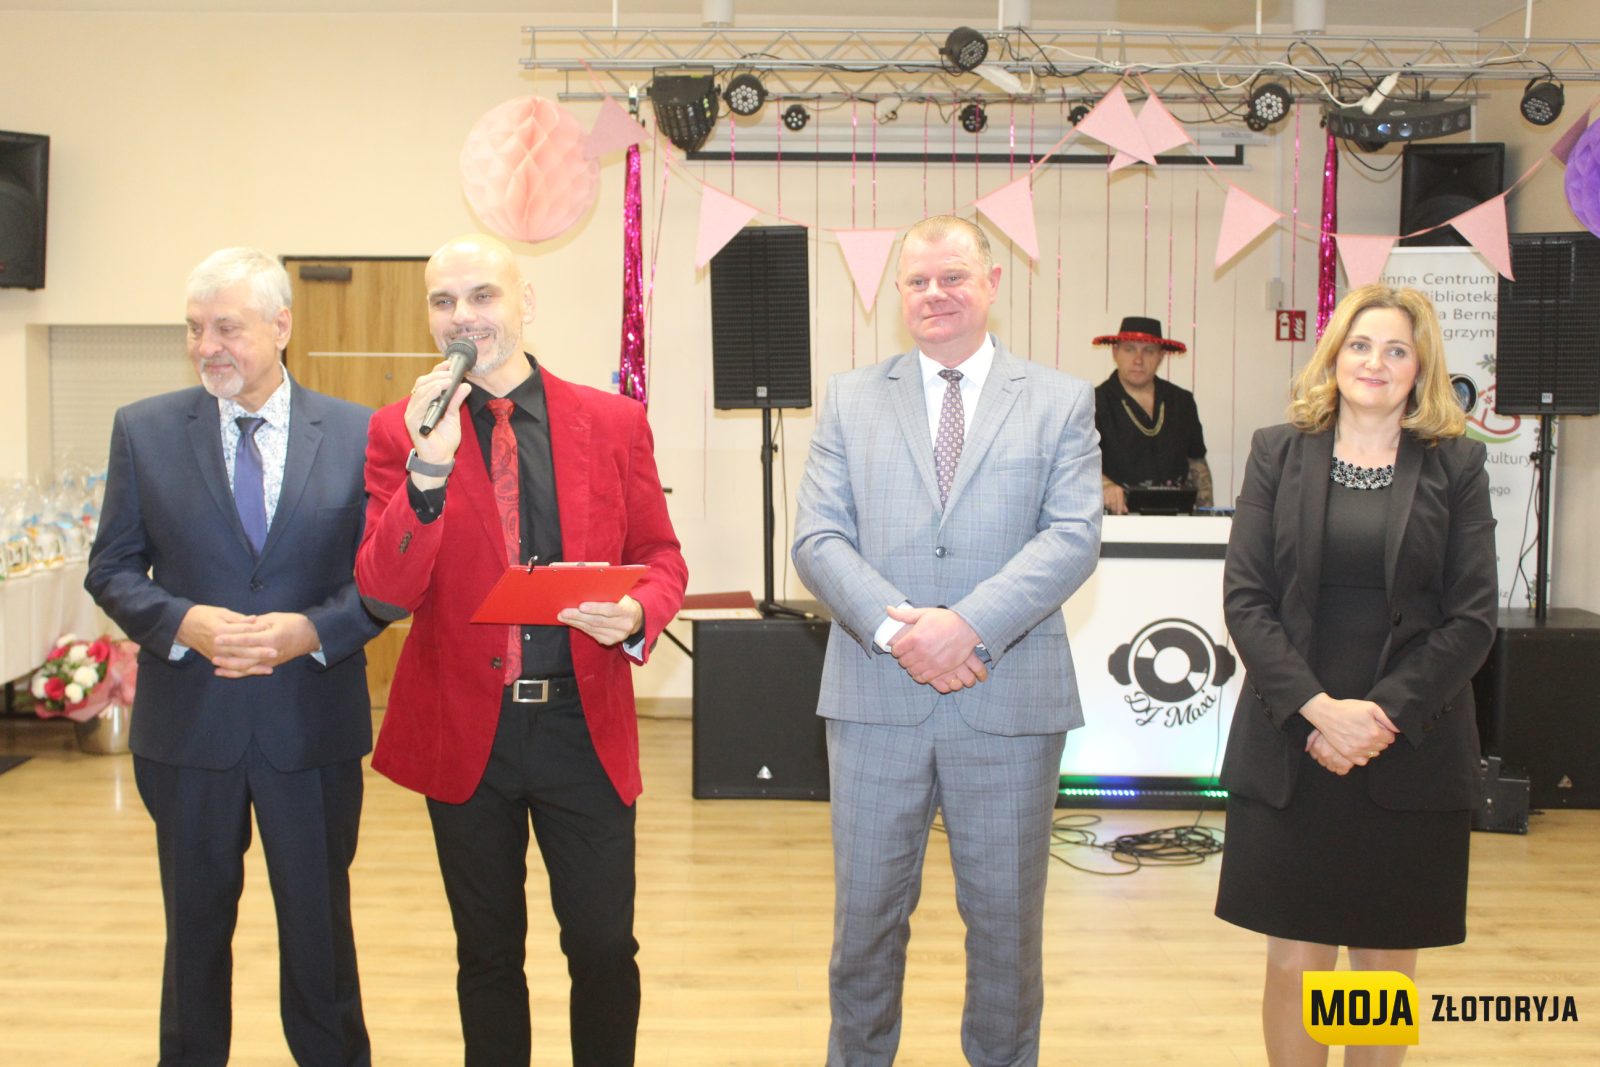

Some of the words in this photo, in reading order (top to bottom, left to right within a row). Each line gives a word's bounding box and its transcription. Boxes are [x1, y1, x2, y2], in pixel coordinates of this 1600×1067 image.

[1423, 273, 1496, 285] Centrum
[1453, 307, 1498, 321] Berna
[1163, 689, 1217, 728] Maxi
